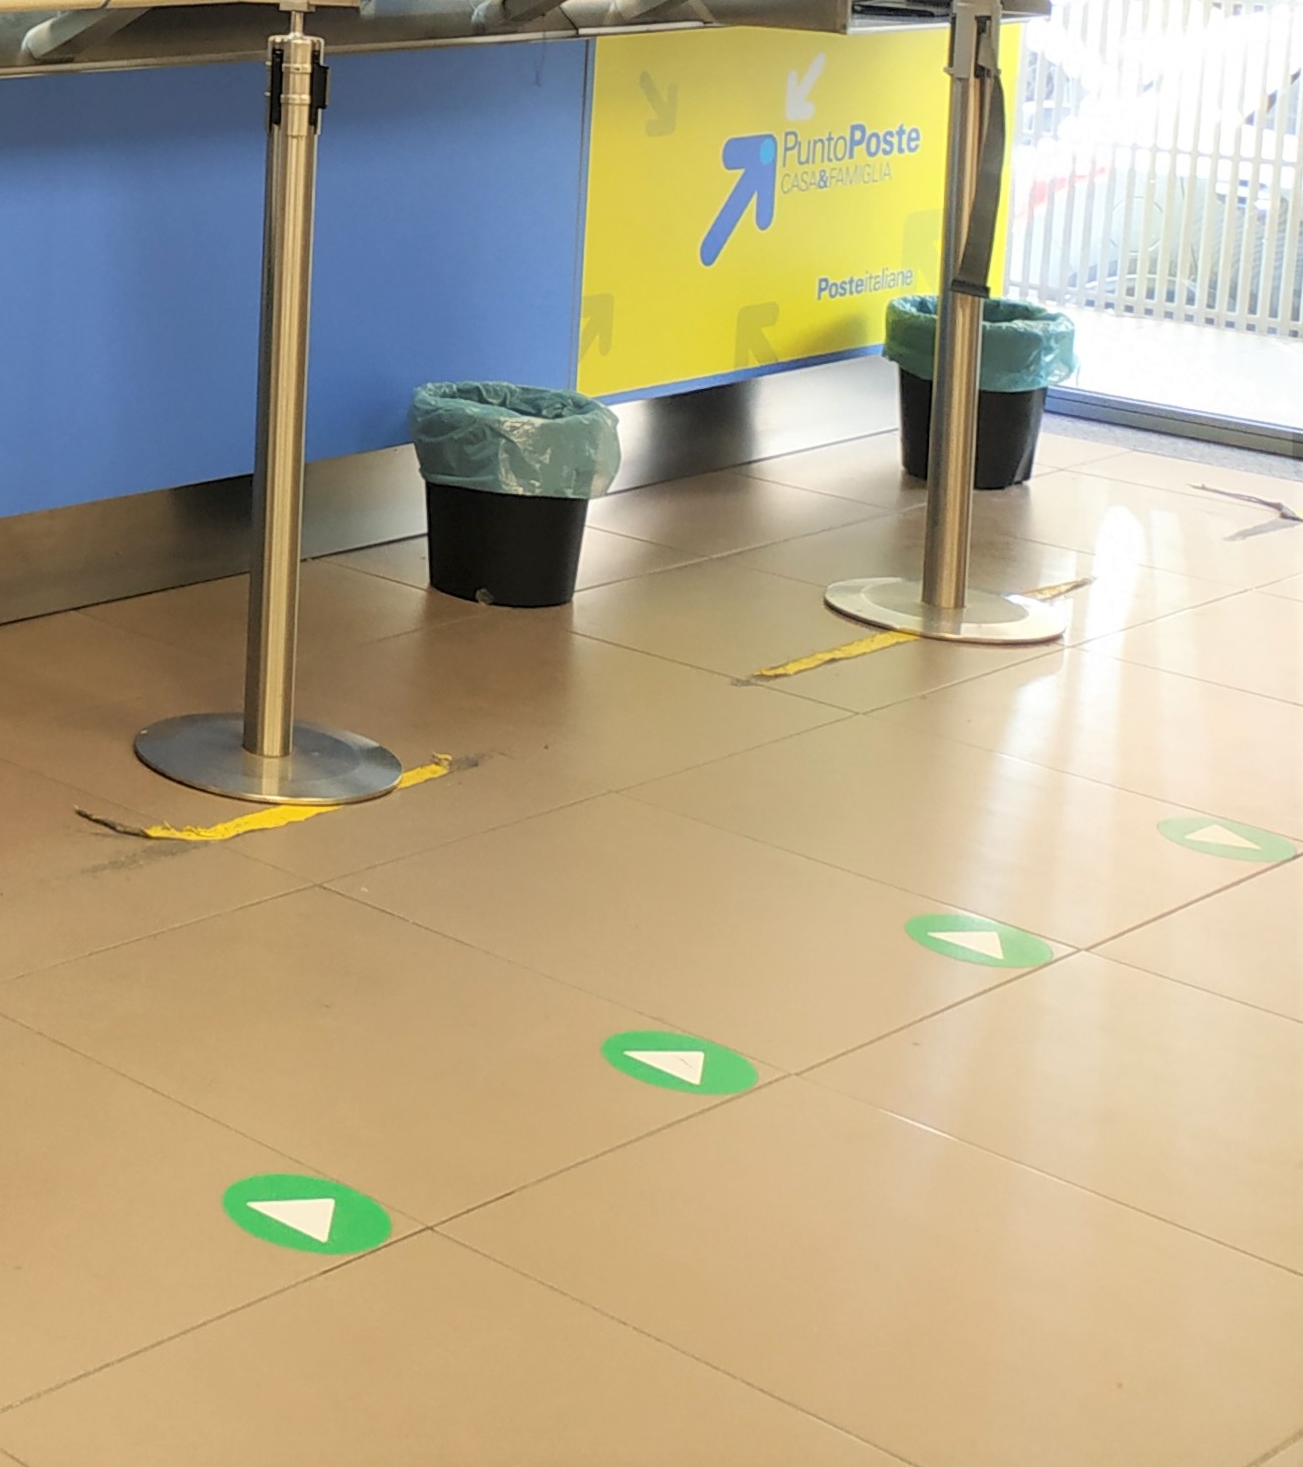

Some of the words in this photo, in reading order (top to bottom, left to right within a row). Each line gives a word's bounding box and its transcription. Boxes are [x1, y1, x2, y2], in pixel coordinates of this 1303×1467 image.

[782, 123, 921, 168] PuntoPoste
[781, 161, 892, 194] CASA&FAMIGLIA
[817, 267, 913, 300] Posteitaliane
